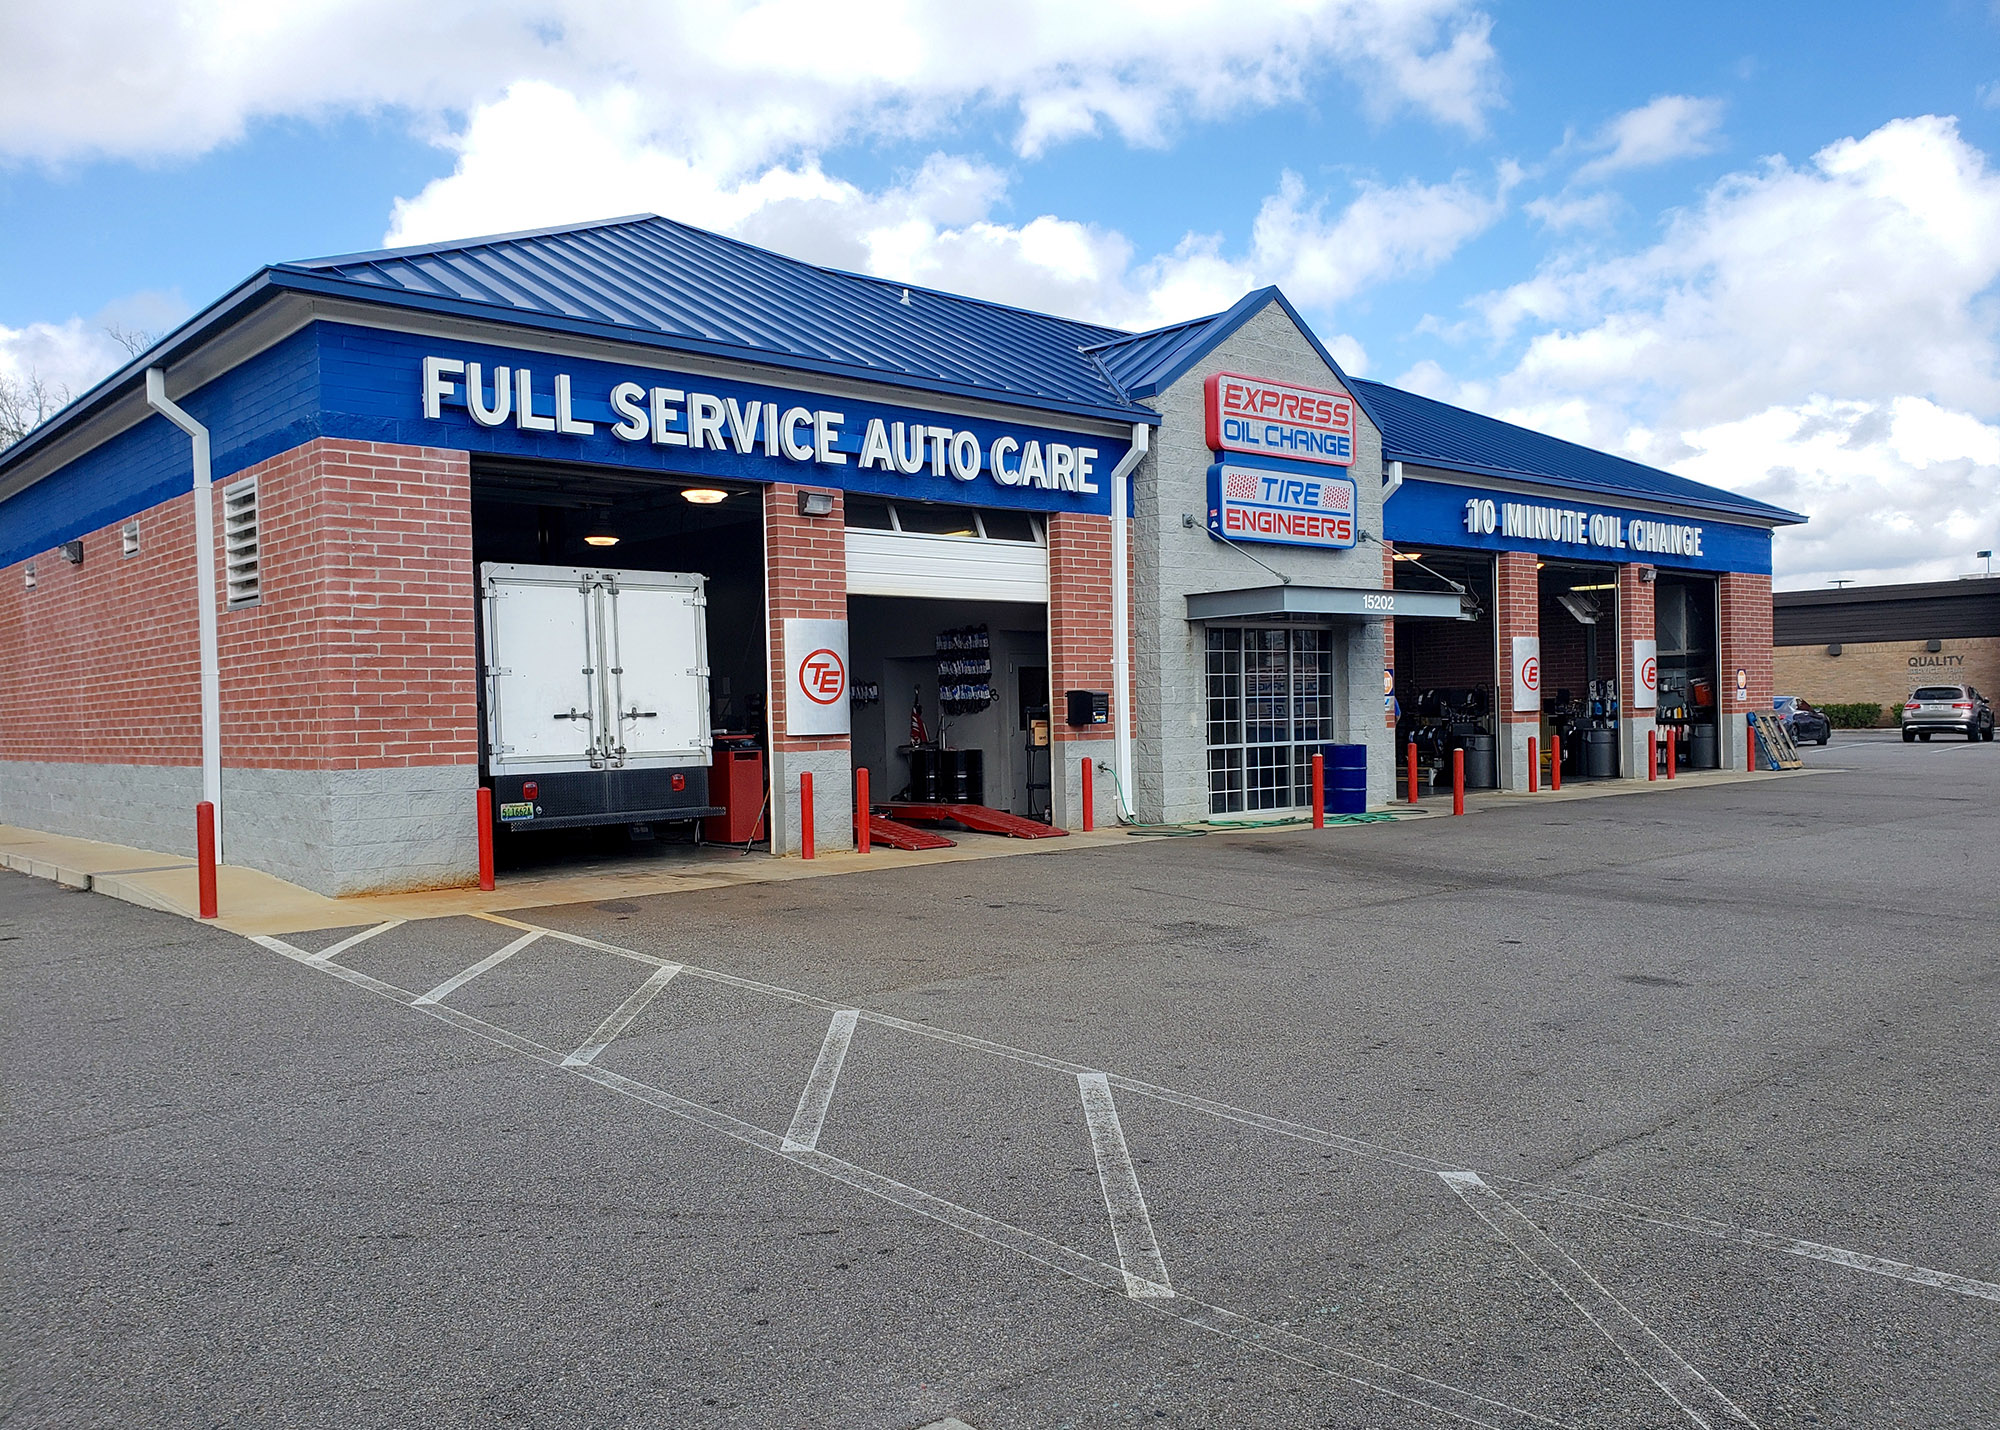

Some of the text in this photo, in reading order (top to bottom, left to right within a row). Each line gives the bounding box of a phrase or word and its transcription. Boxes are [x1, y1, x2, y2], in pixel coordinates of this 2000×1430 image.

[1223, 383, 1350, 427] EXPRESS
[423, 356, 1100, 494] FULL SERVICE AUTO CARE
[1223, 419, 1350, 457] OIL CHANGE
[1261, 477, 1322, 507] TIRE
[1226, 508, 1351, 540] ENGINEERS
[1465, 498, 1704, 557] 10 MINUTE OIL CHANGE
[1362, 594, 1395, 611] 15202
[807, 662, 841, 693] TE
[1908, 656, 1964, 667] QUALITY
